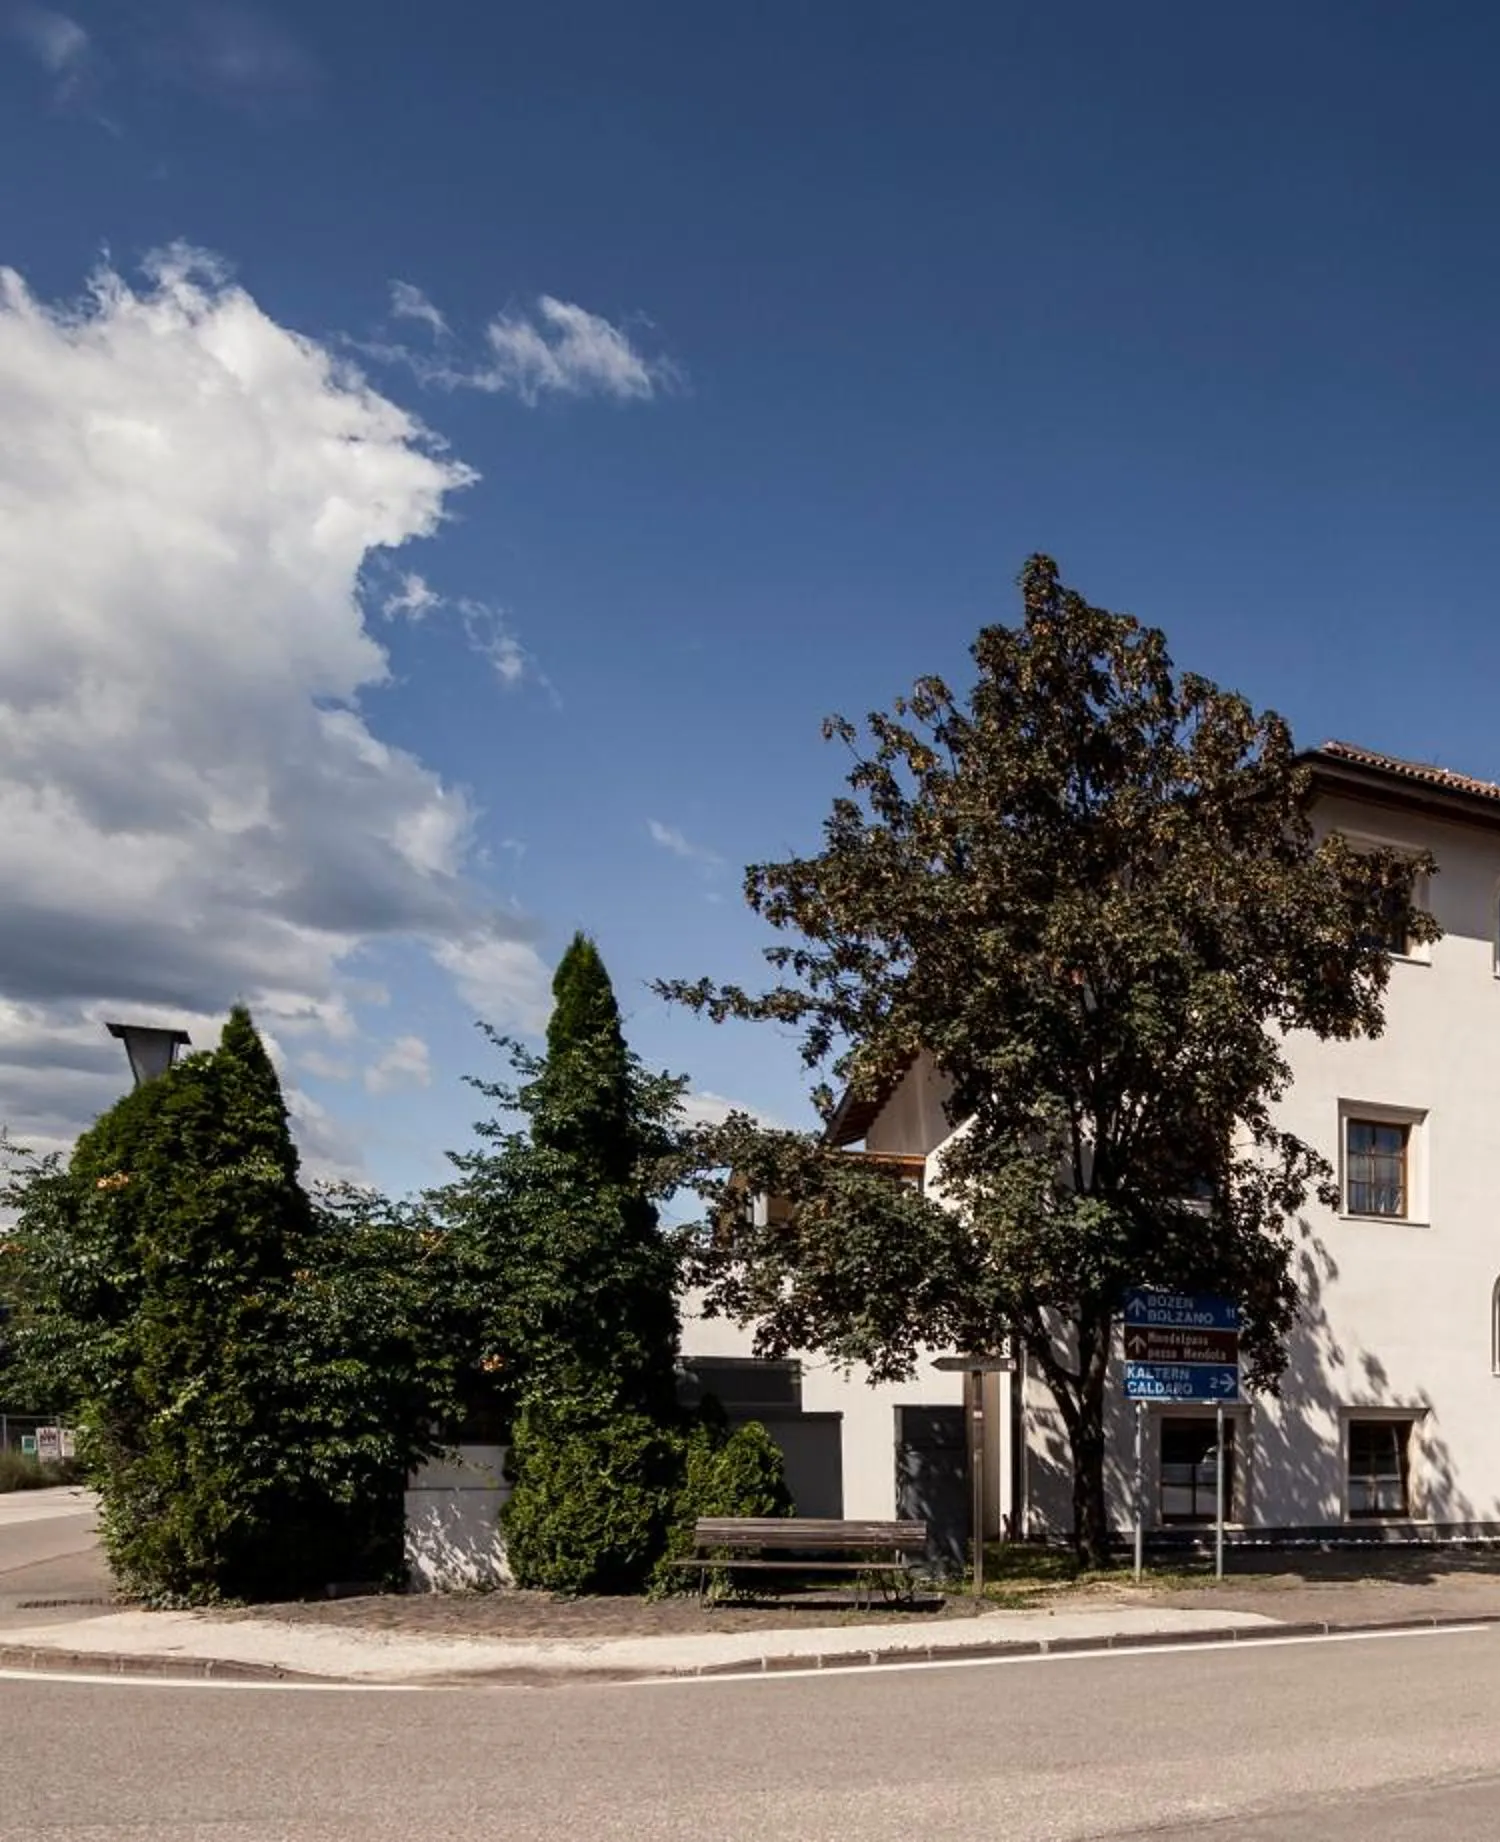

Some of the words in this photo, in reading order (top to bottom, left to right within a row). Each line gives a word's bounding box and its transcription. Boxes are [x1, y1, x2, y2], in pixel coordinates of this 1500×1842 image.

[1147, 1294, 1194, 1308] BOZEN
[1147, 1310, 1215, 1324] BOLZANO
[1127, 1367, 1190, 1380] KALTERN
[1209, 1377, 1219, 1389] 2
[1127, 1381, 1193, 1395] CALDARO
